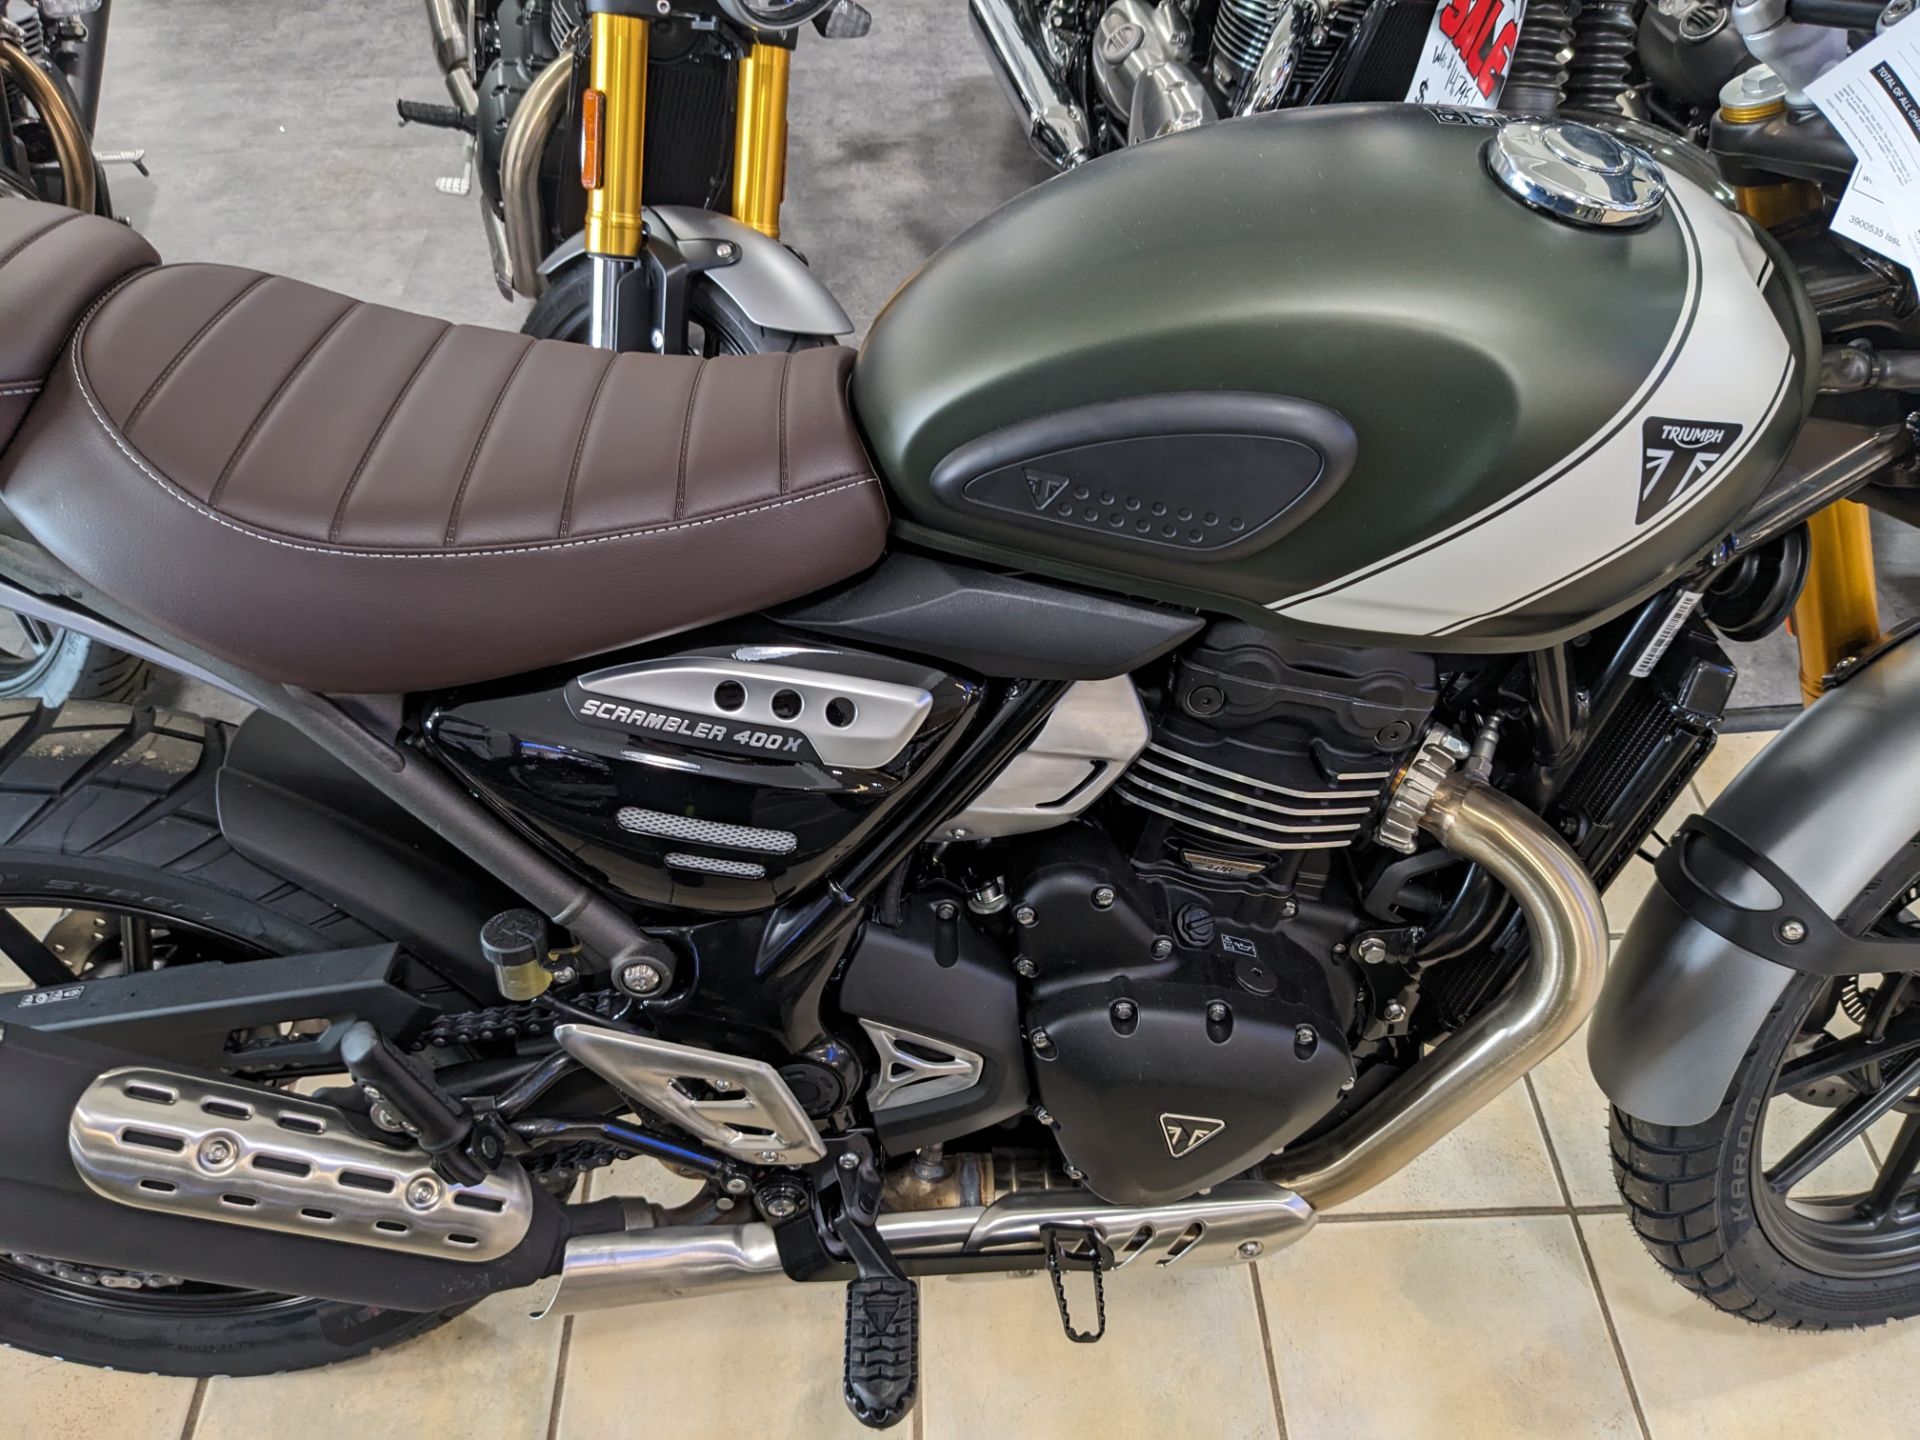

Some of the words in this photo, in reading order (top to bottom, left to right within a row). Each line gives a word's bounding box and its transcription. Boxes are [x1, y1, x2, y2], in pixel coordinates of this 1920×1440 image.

[1876, 66, 1894, 89] TOTAL
[1892, 86, 1904, 100] OF
[1899, 97, 1912, 112] ALL
[1848, 215, 1884, 238] 3900535
[1661, 425, 1725, 448] TRIUMPH
[580, 699, 727, 742] SCRAMBLER
[1731, 1097, 1761, 1223] KAROO
